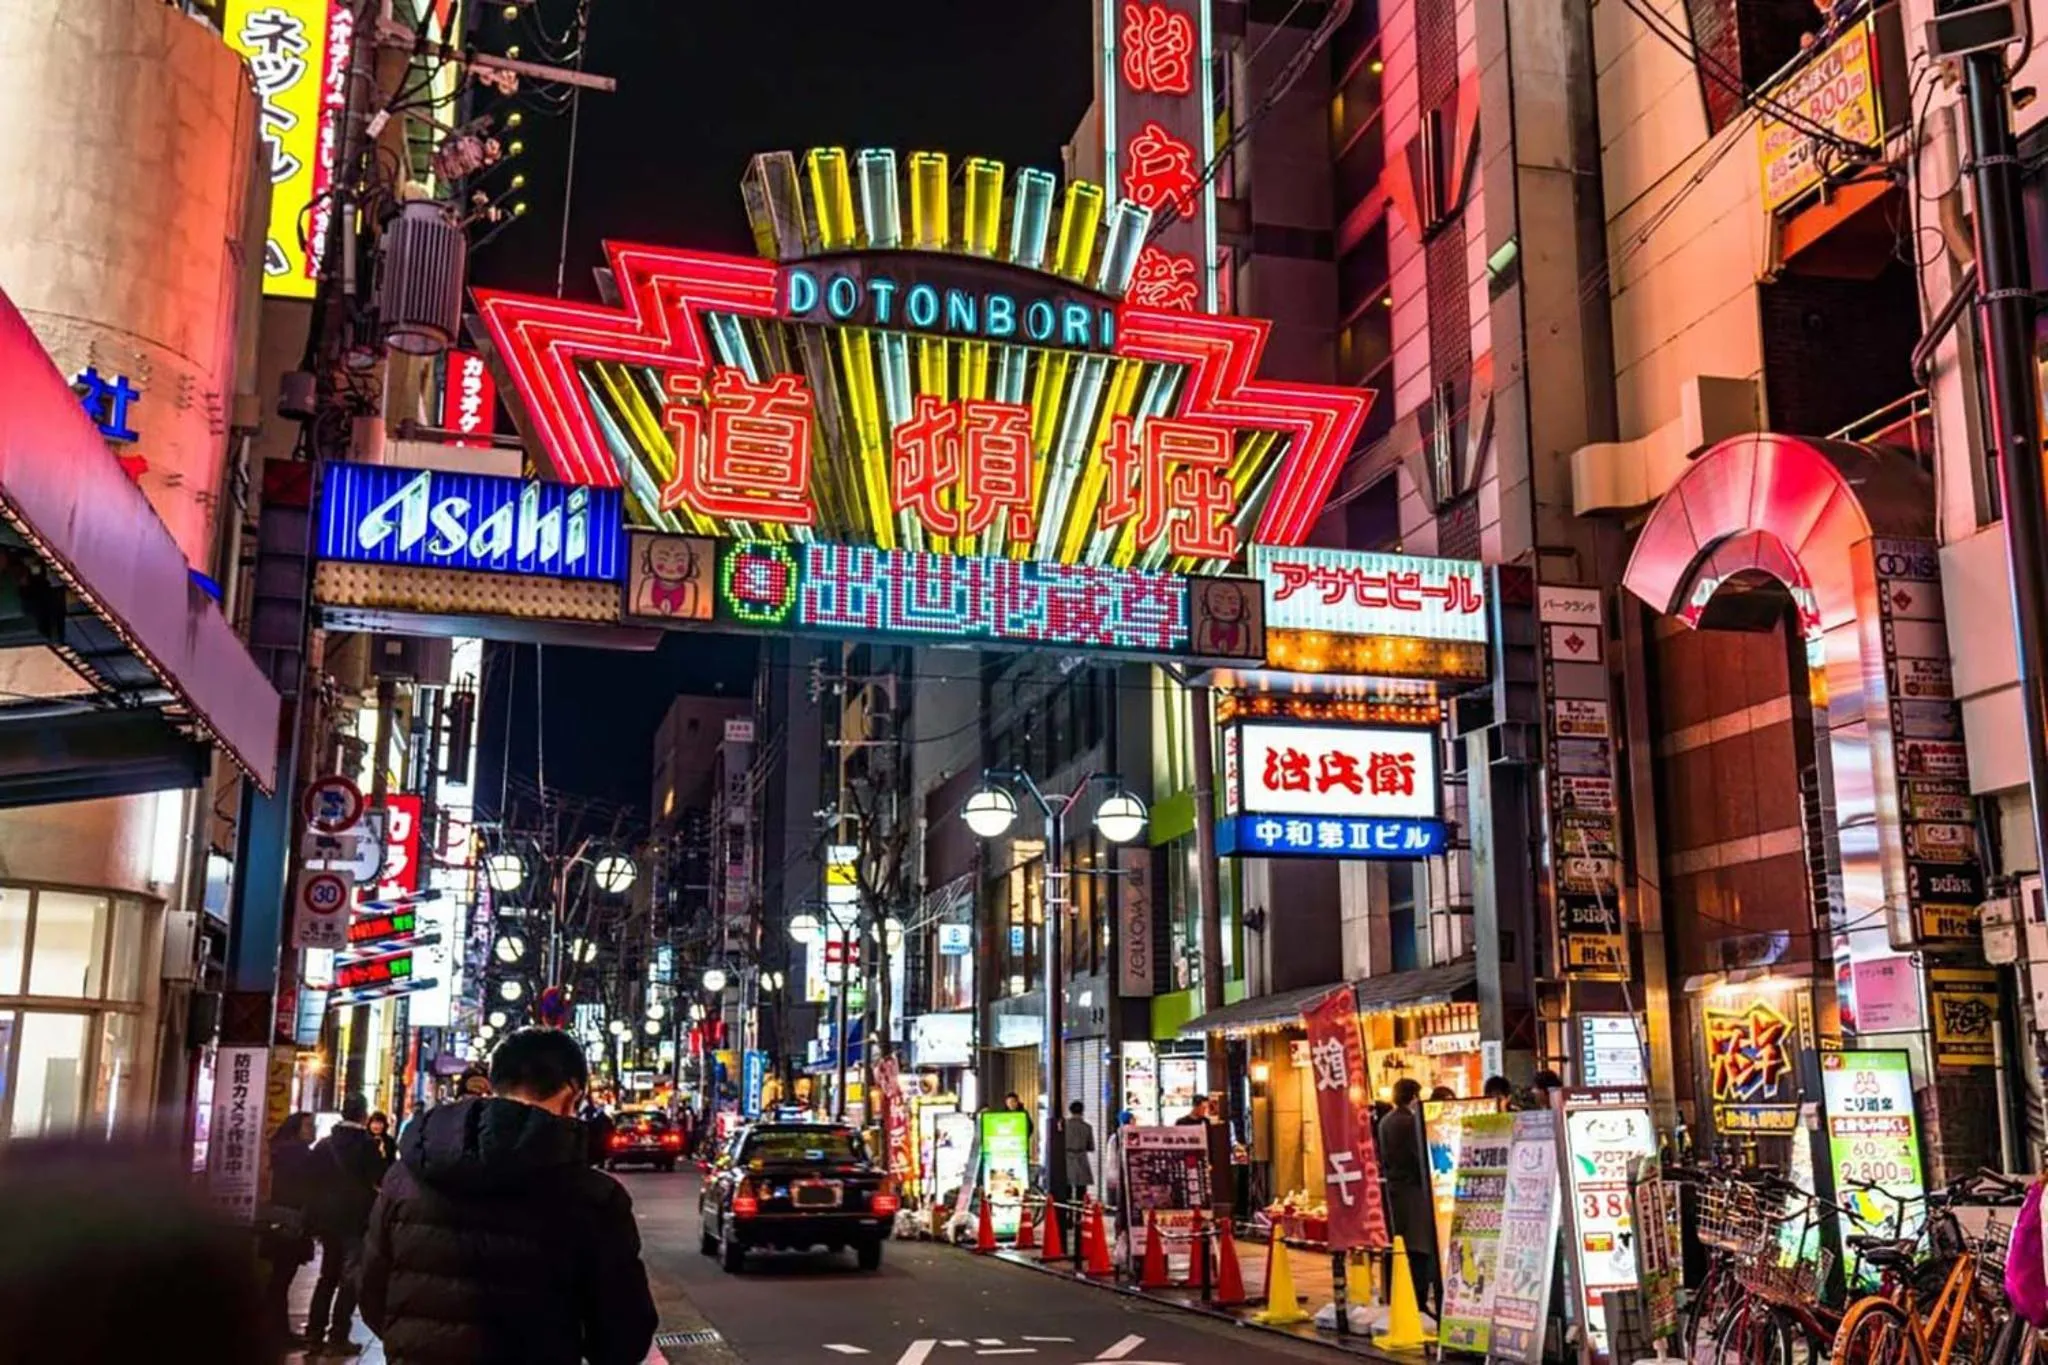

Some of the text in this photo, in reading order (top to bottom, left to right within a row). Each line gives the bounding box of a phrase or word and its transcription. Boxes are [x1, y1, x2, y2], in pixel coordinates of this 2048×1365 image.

[787, 267, 1114, 347] DOTONBORI
[460, 356, 484, 433] カラオケ
[661, 366, 1236, 560] 道頓堀
[358, 470, 589, 565] Asahi
[801, 541, 1190, 649] 出世地蔵尊
[1270, 561, 1483, 614] アサヒビール
[1262, 745, 1416, 797] 治兵衛
[1255, 820, 1432, 850] 中和第Ⅱビル
[314, 884, 338, 903] 30
[225, 1052, 251, 1175] 防犯カメラ作動中
